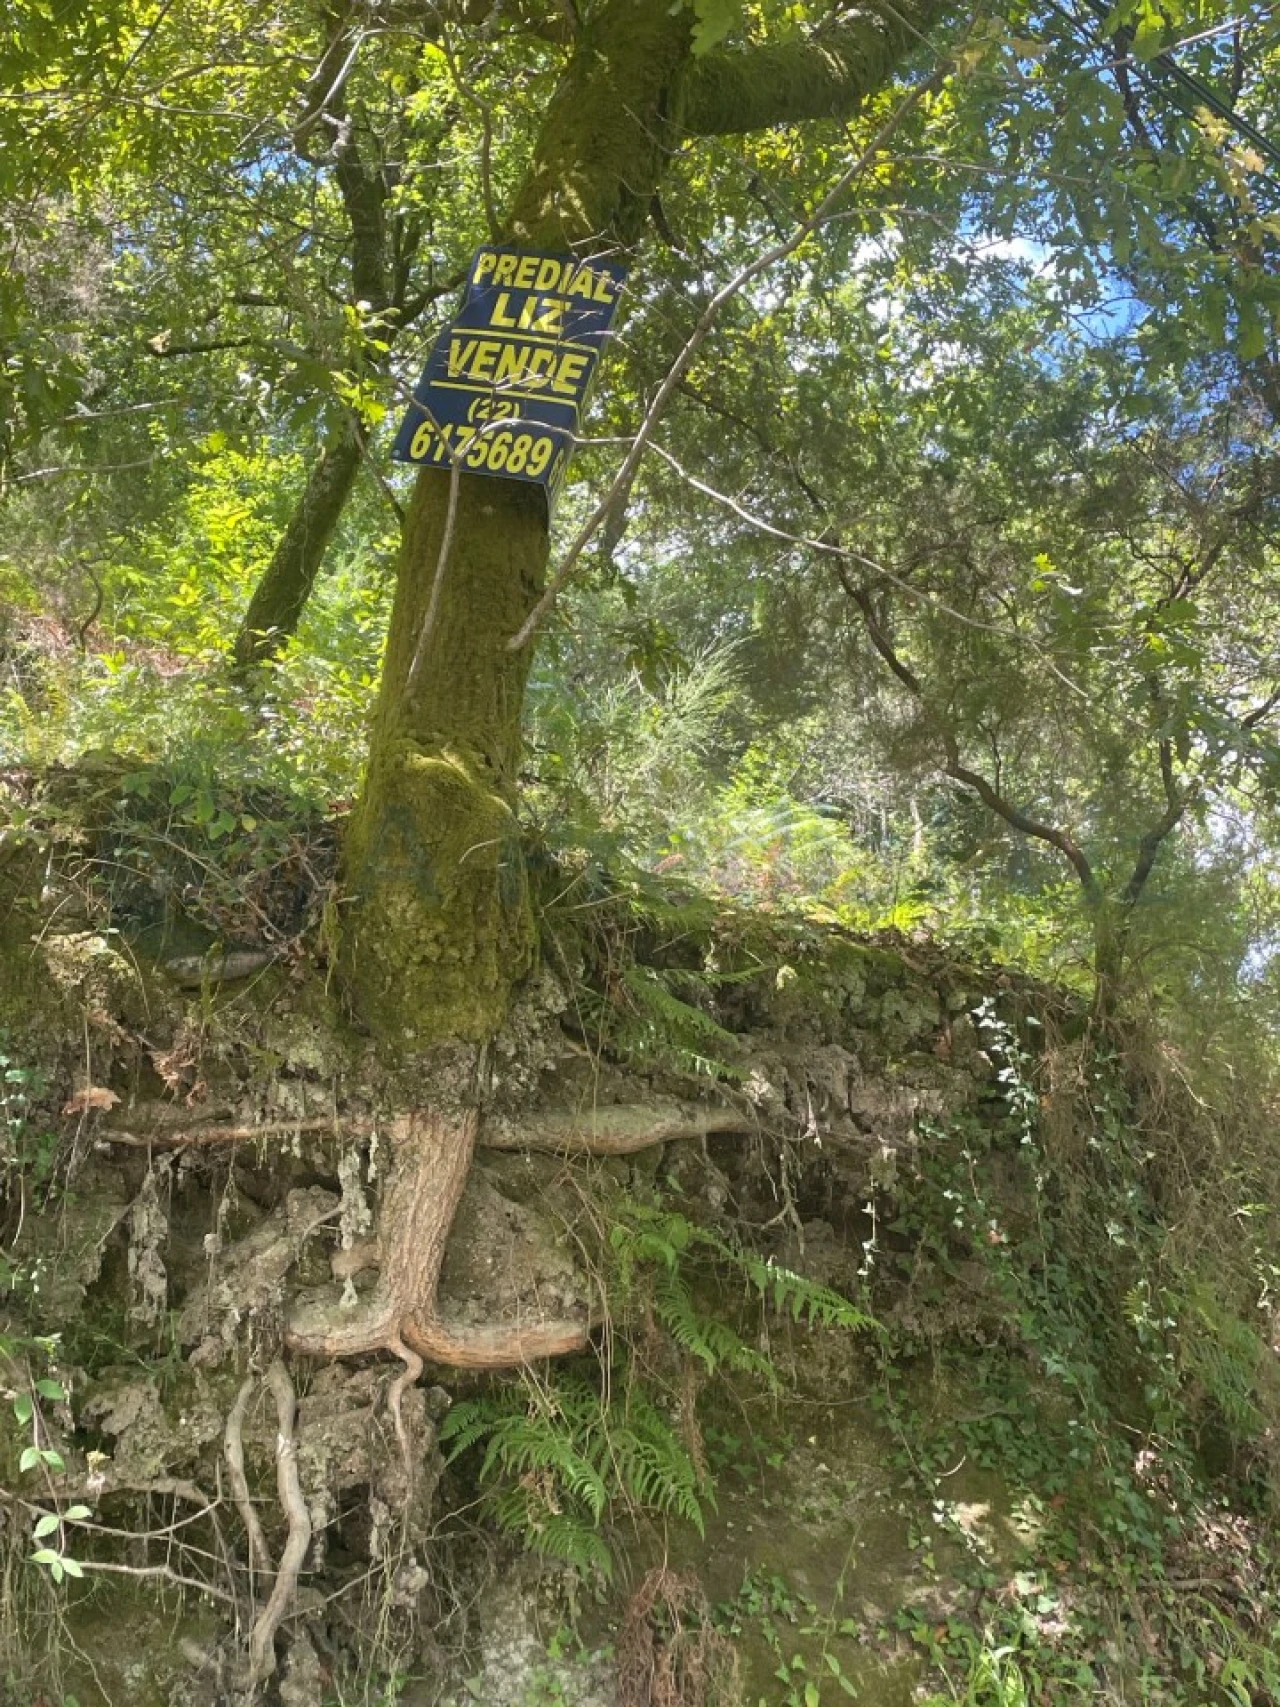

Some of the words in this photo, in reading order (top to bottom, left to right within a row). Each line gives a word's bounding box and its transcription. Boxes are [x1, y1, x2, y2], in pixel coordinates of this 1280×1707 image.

[473, 252, 613, 304] PREDIAL
[490, 293, 571, 335] LIZ
[447, 339, 589, 395] VENDE
[467, 398, 520, 423] (22)
[410, 420, 554, 476] 6175689
